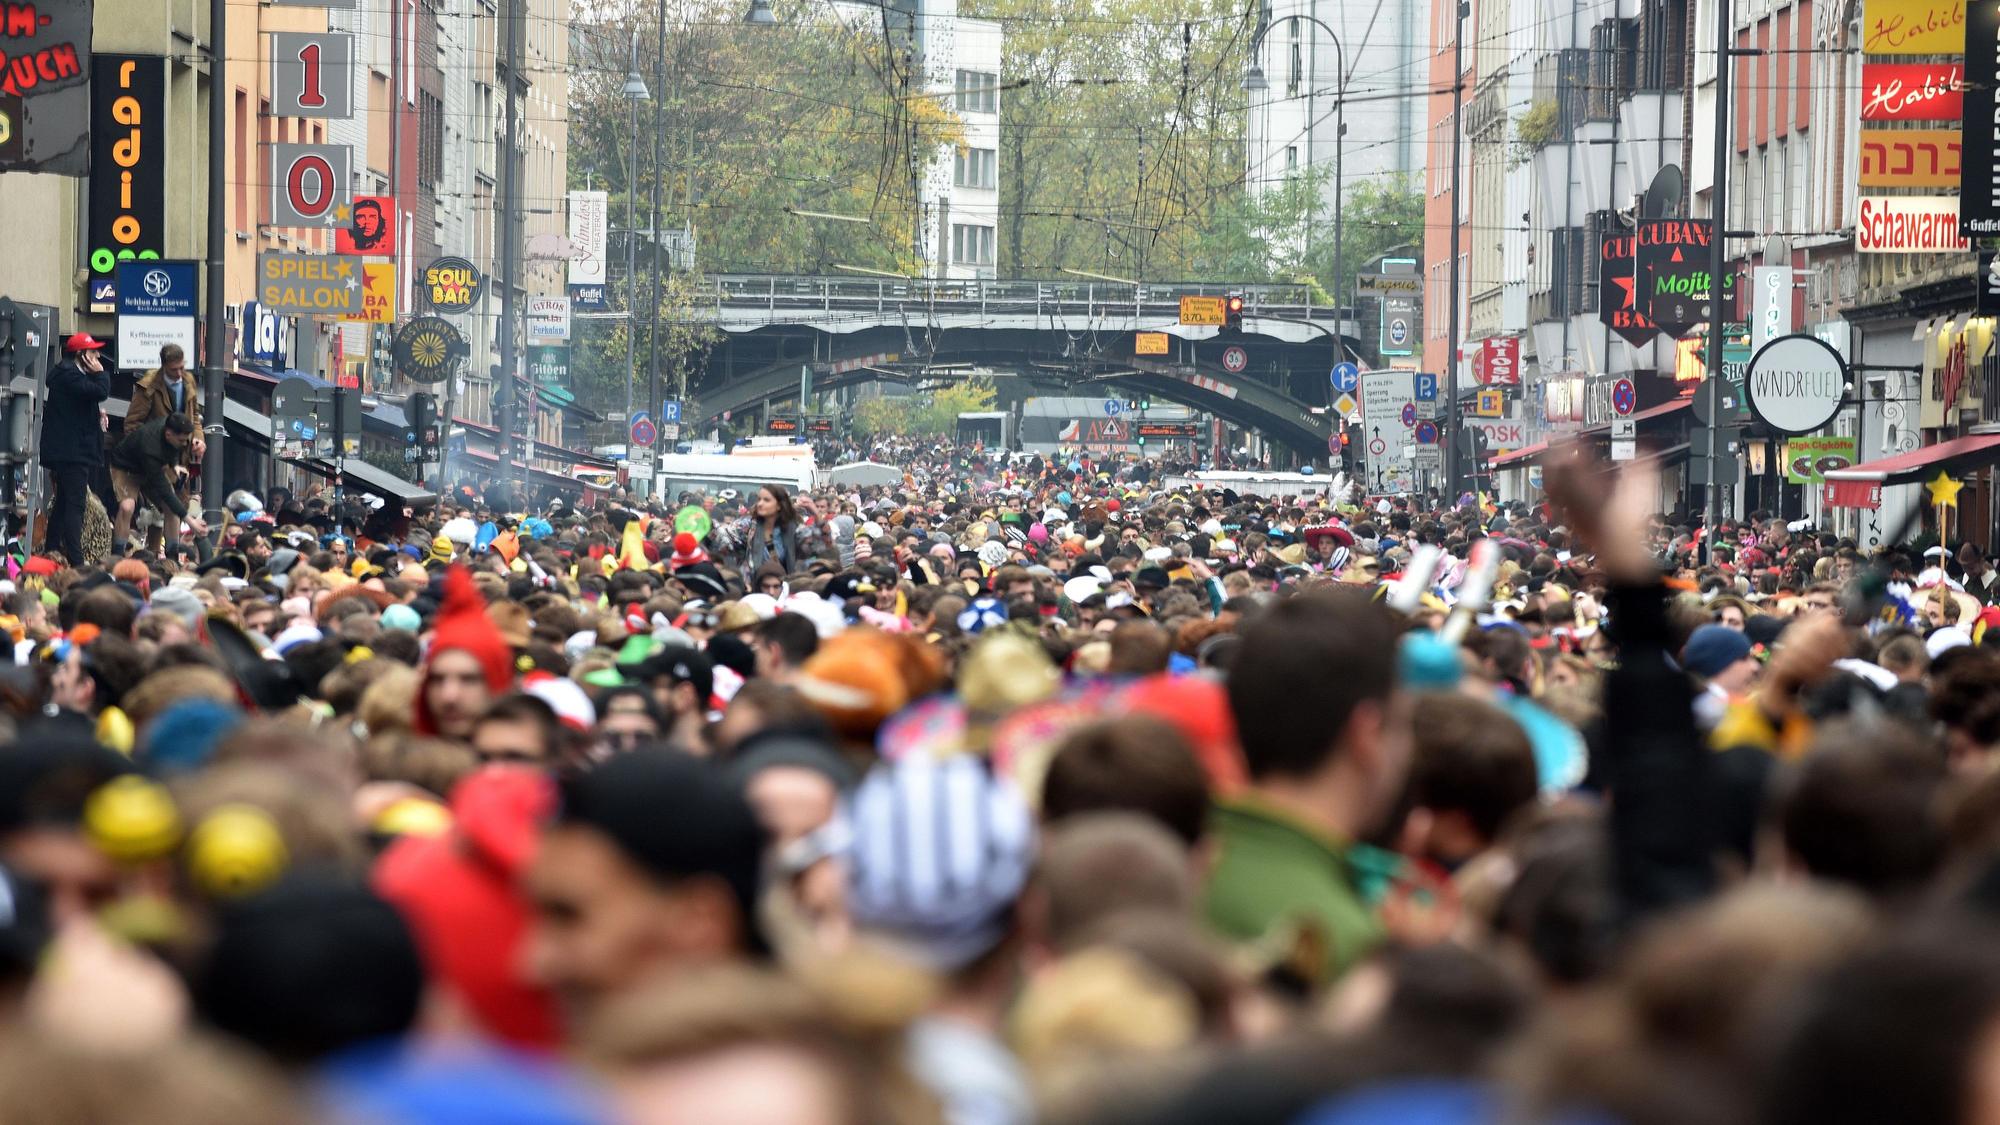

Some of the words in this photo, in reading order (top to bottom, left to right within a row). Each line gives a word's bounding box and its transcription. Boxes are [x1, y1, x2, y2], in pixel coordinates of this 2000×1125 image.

[1866, 2, 1964, 50] Habib
[1863, 67, 1961, 118] Habib
[111, 60, 141, 244] radio
[265, 258, 336, 281] SPIEL
[426, 268, 478, 287] SOUL
[432, 286, 471, 305] BAR
[1655, 271, 1734, 297] Mojits
[265, 286, 350, 309] SALON
[532, 300, 565, 312] GYROS
[1490, 338, 1514, 384] KIOSK
[1754, 369, 1840, 398] WNDRFUEL
